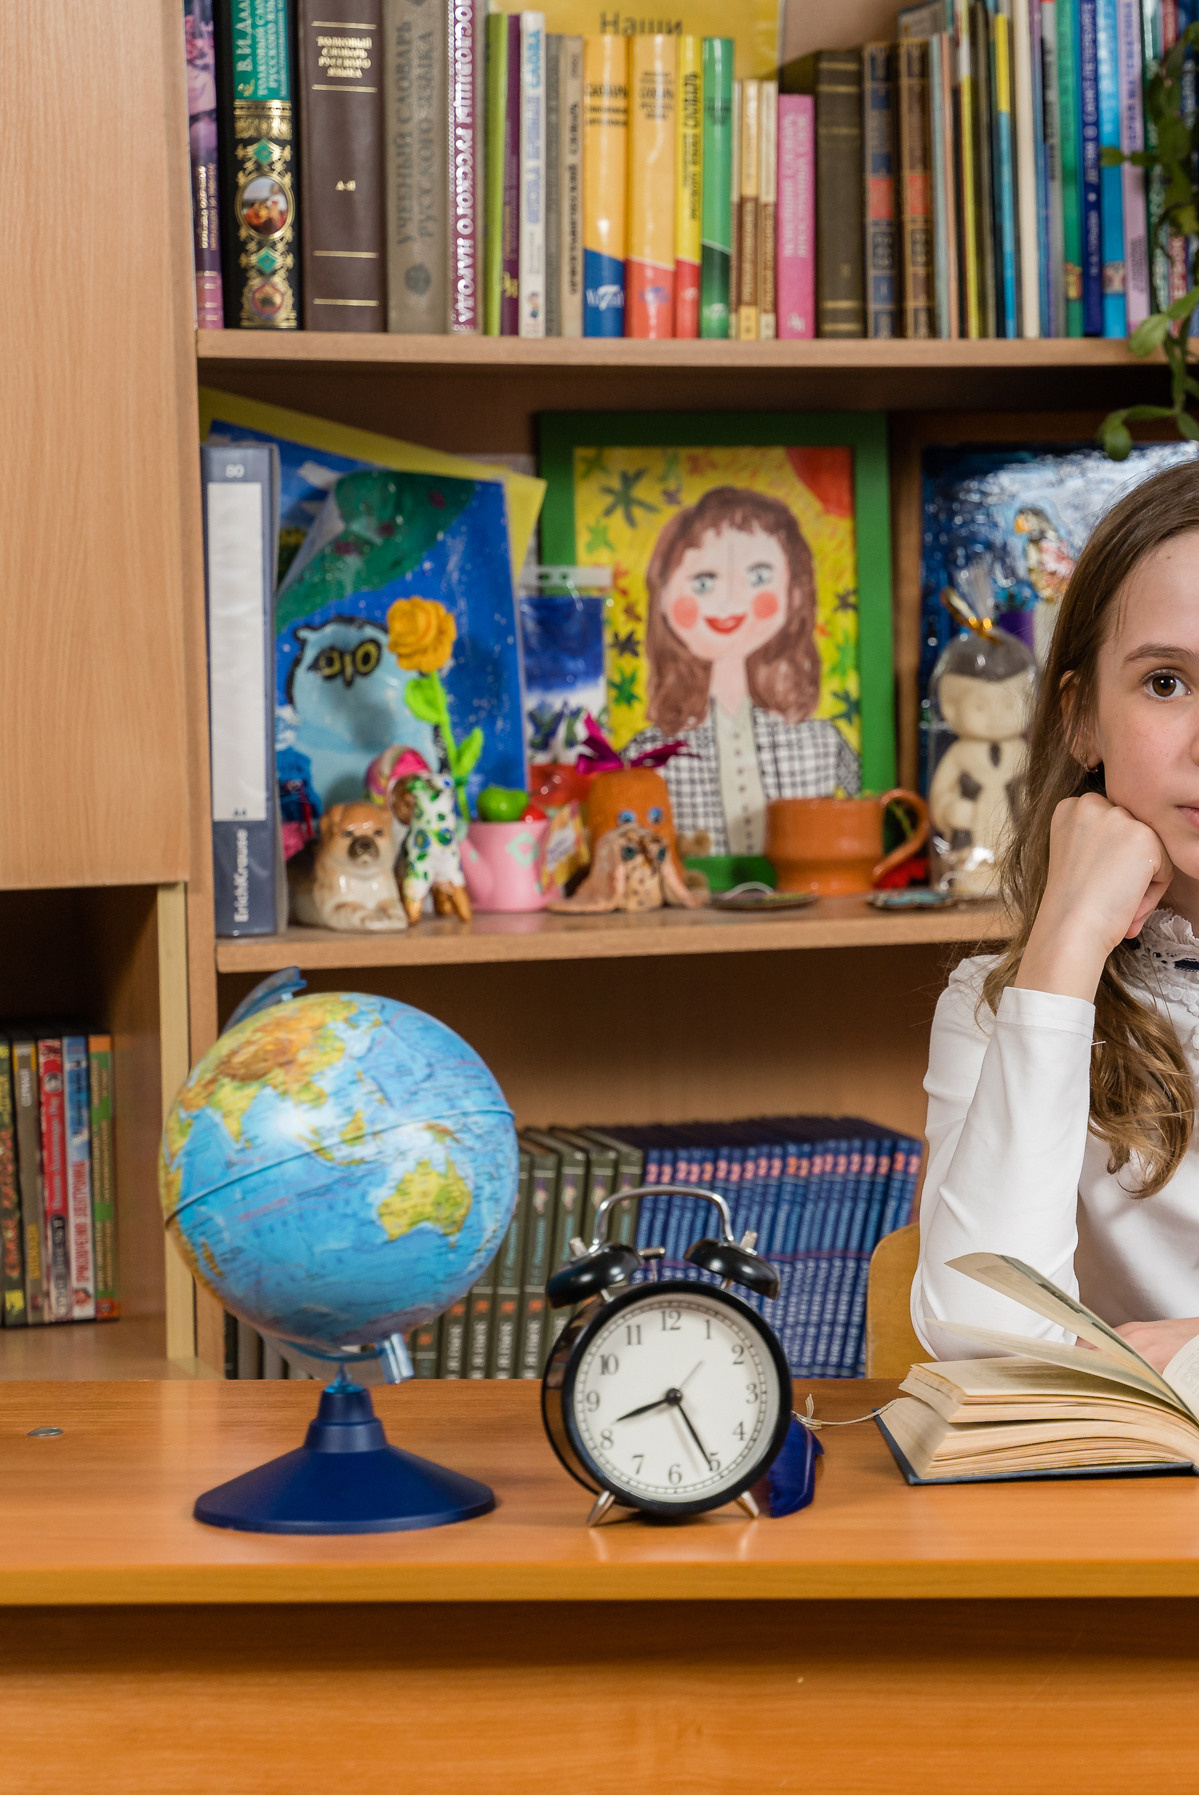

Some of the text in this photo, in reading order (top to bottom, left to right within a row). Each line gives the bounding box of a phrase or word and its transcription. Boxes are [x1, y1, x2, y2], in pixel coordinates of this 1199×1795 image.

[394, 21, 413, 125] СЛОВАРЬ
[455, 127, 475, 235] РУССКОГО
[455, 238, 477, 323] НАРОДА
[233, 828, 249, 922] ErichKrause
[661, 1310, 681, 1331] 12
[703, 1319, 712, 1340] 1
[626, 1324, 641, 1346] 11
[600, 1354, 619, 1375] 10
[732, 1344, 744, 1365] 2
[586, 1391, 600, 1412] 9
[746, 1383, 759, 1404] 3
[601, 1429, 613, 1450] 8
[732, 1421, 746, 1441] 4
[633, 1454, 645, 1474] 7
[710, 1452, 721, 1472] 5
[668, 1464, 682, 1485] 6
